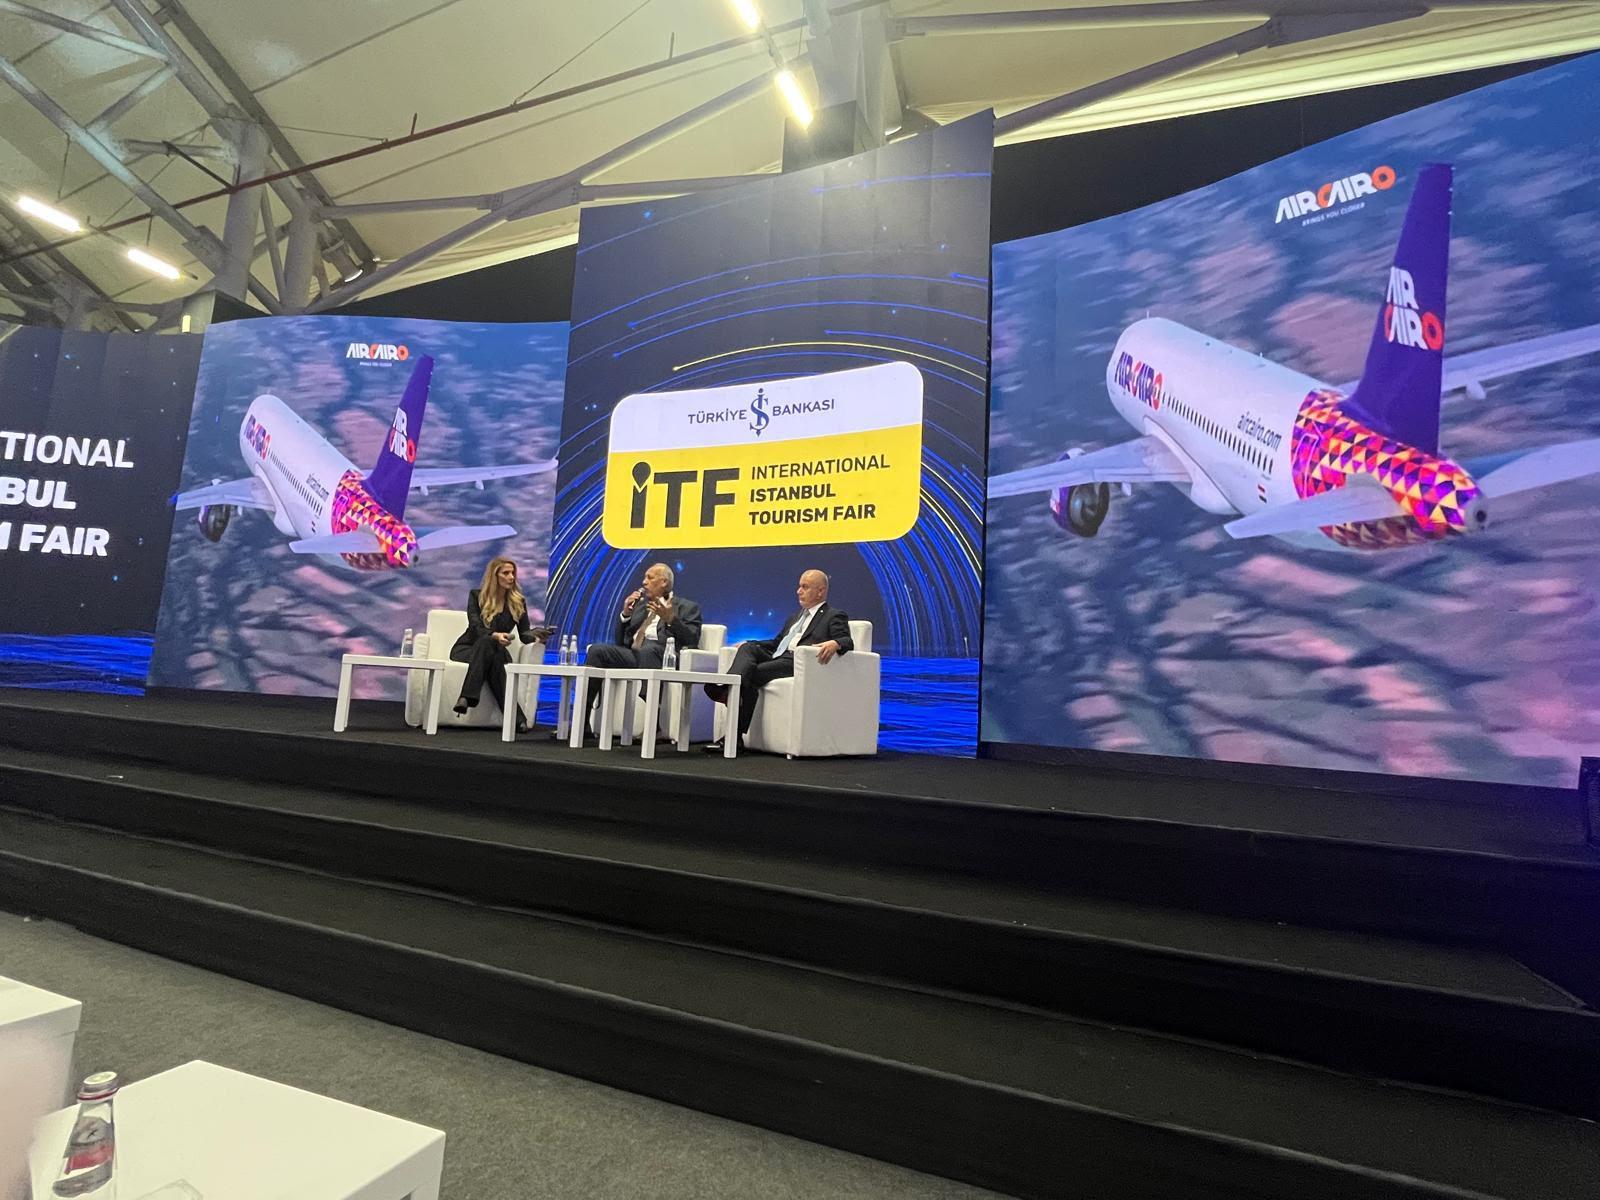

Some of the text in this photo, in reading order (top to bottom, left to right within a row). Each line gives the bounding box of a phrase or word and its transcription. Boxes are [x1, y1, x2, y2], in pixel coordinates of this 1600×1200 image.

[687, 408, 748, 425] TÜRKİYE
[772, 398, 836, 417] BANKASI
[1237, 411, 1283, 452] aircairo.com
[751, 453, 892, 481] INTERNATIONAL
[750, 483, 837, 504] ISTANBUL
[749, 503, 876, 526] TOURISM FAIR
[19, 522, 110, 557] FAIR
